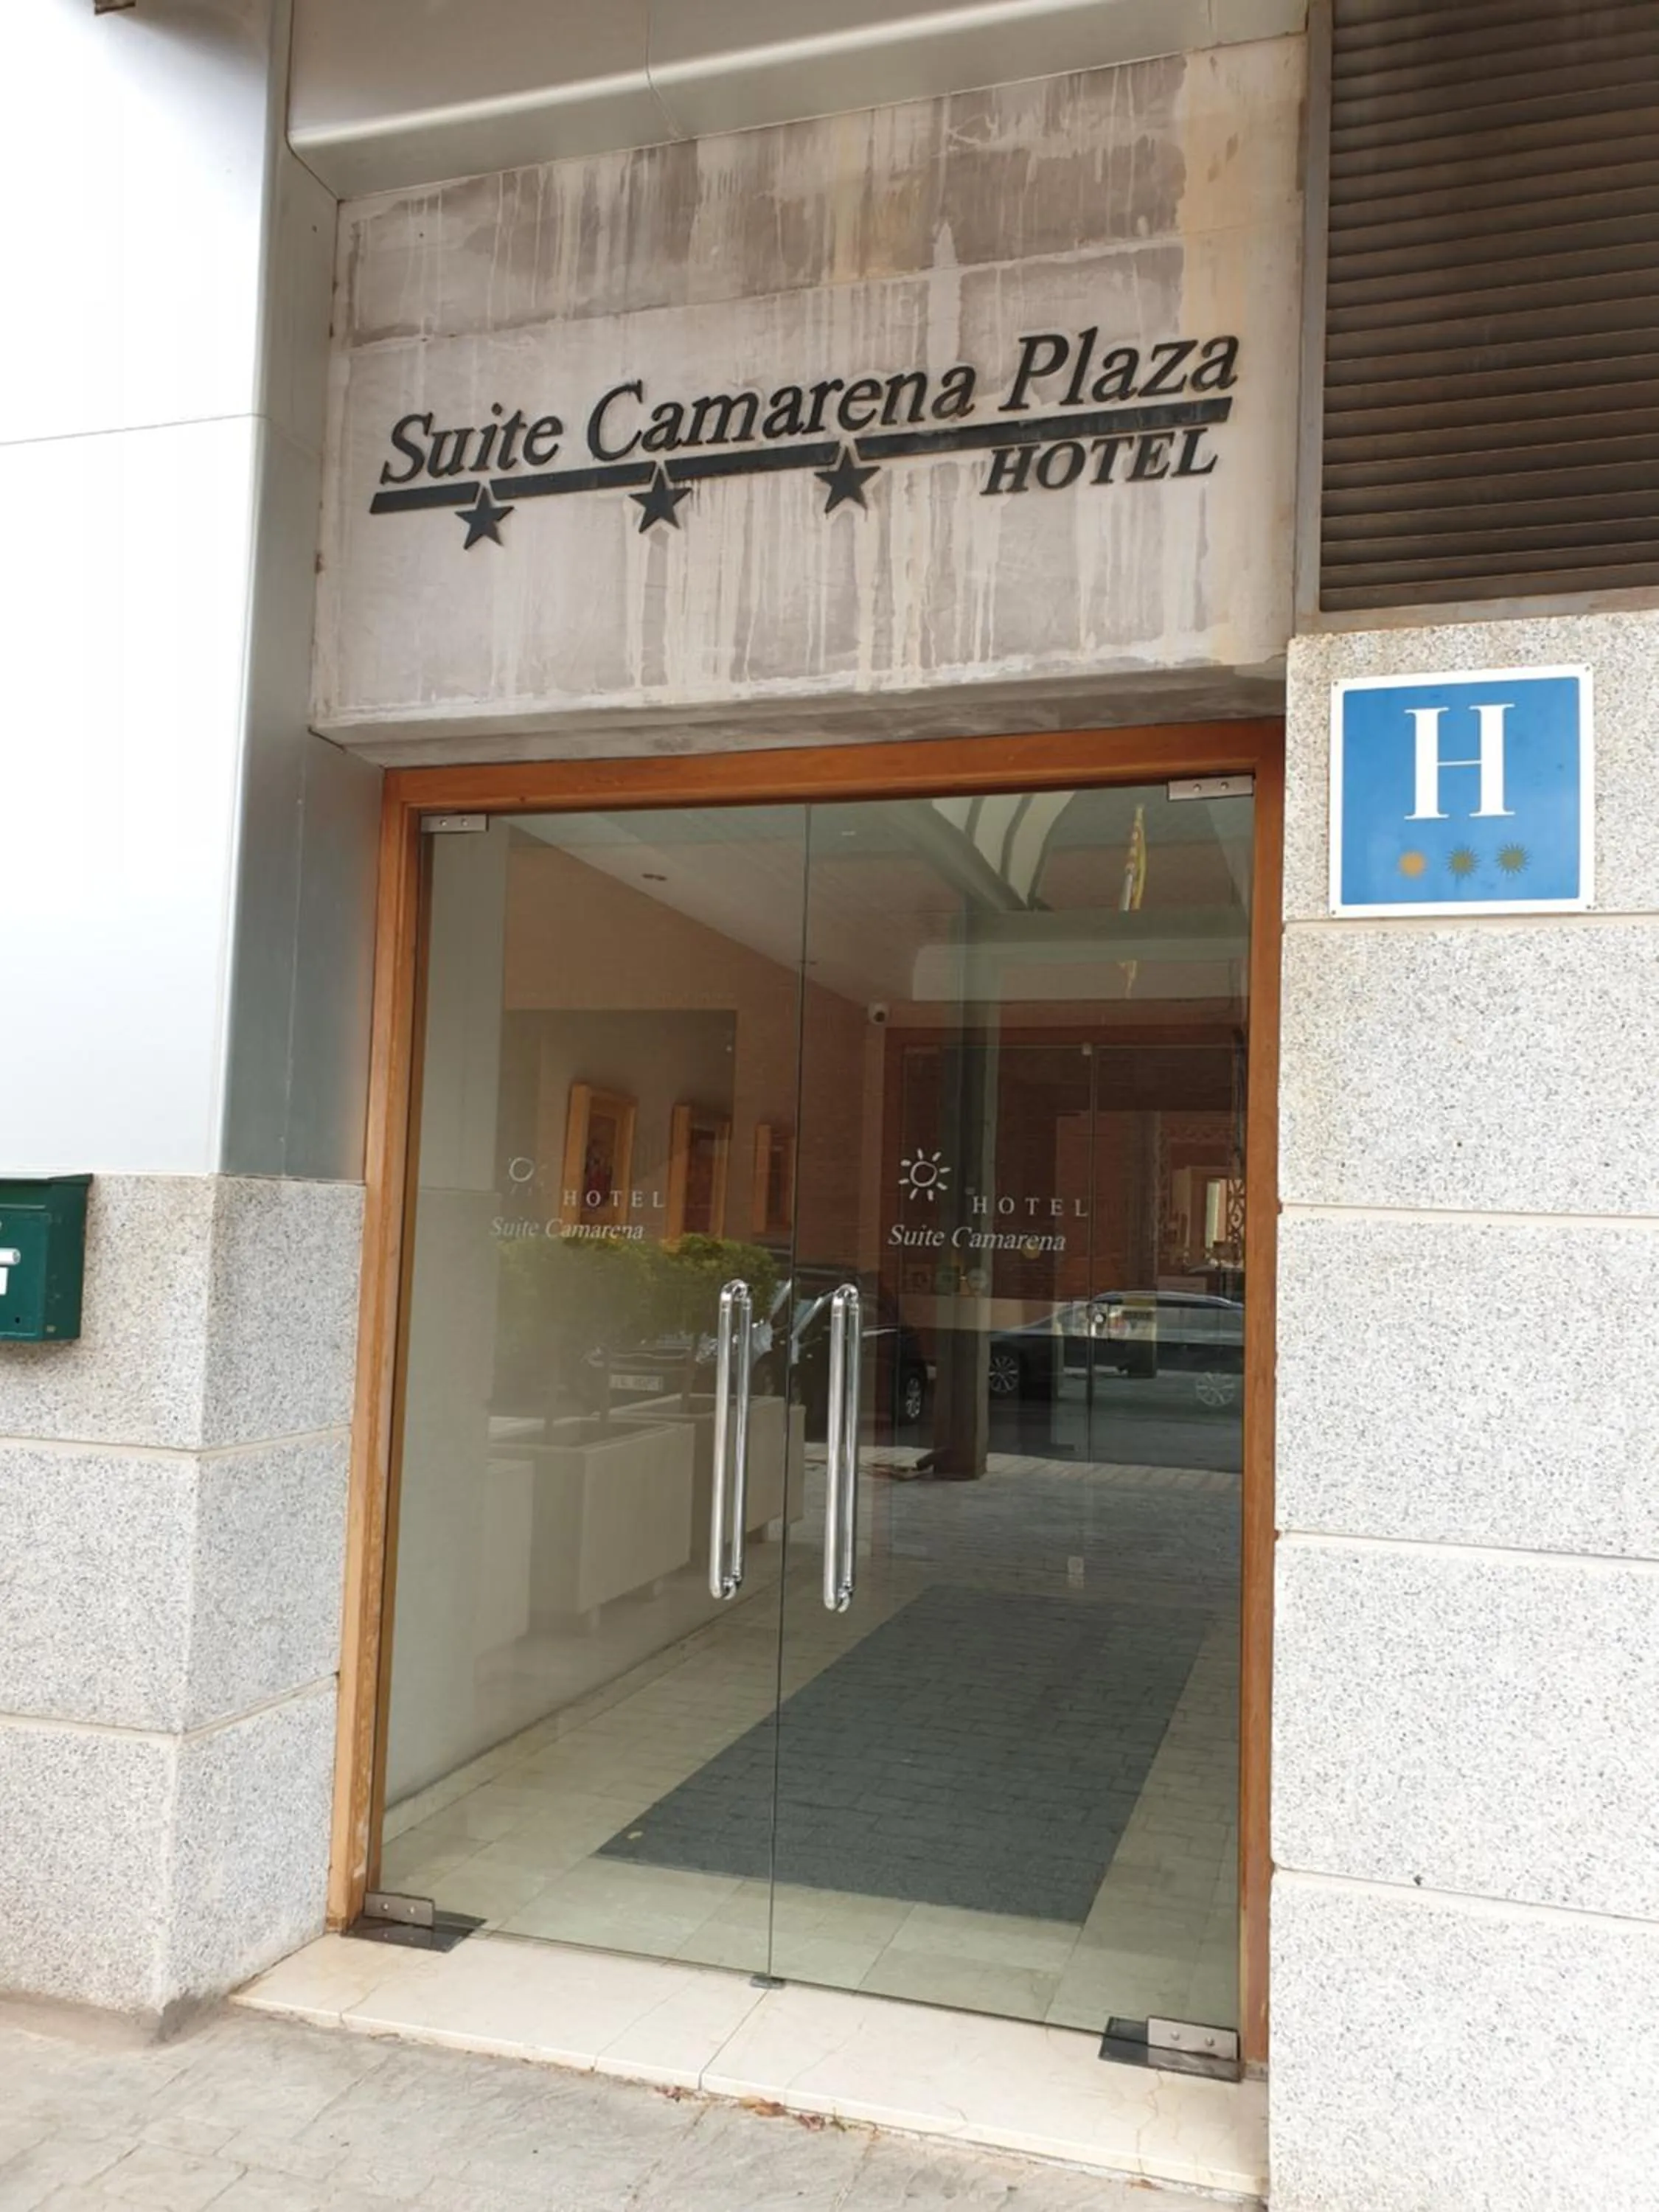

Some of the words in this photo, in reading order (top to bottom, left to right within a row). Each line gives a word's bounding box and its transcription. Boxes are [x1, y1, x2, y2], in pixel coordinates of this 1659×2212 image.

[380, 402, 563, 484] Suite
[588, 364, 976, 462] Camarena
[997, 326, 1239, 411] Plaza
[980, 426, 1219, 496] HOTEL
[1404, 703, 1515, 820] H
[563, 1191, 665, 1208] HOTEL
[973, 1197, 1089, 1217] HOTEL
[490, 1217, 539, 1237] Suite
[545, 1218, 644, 1240] Camarena
[888, 1224, 945, 1246] Suite
[951, 1226, 1067, 1252] Camarena
